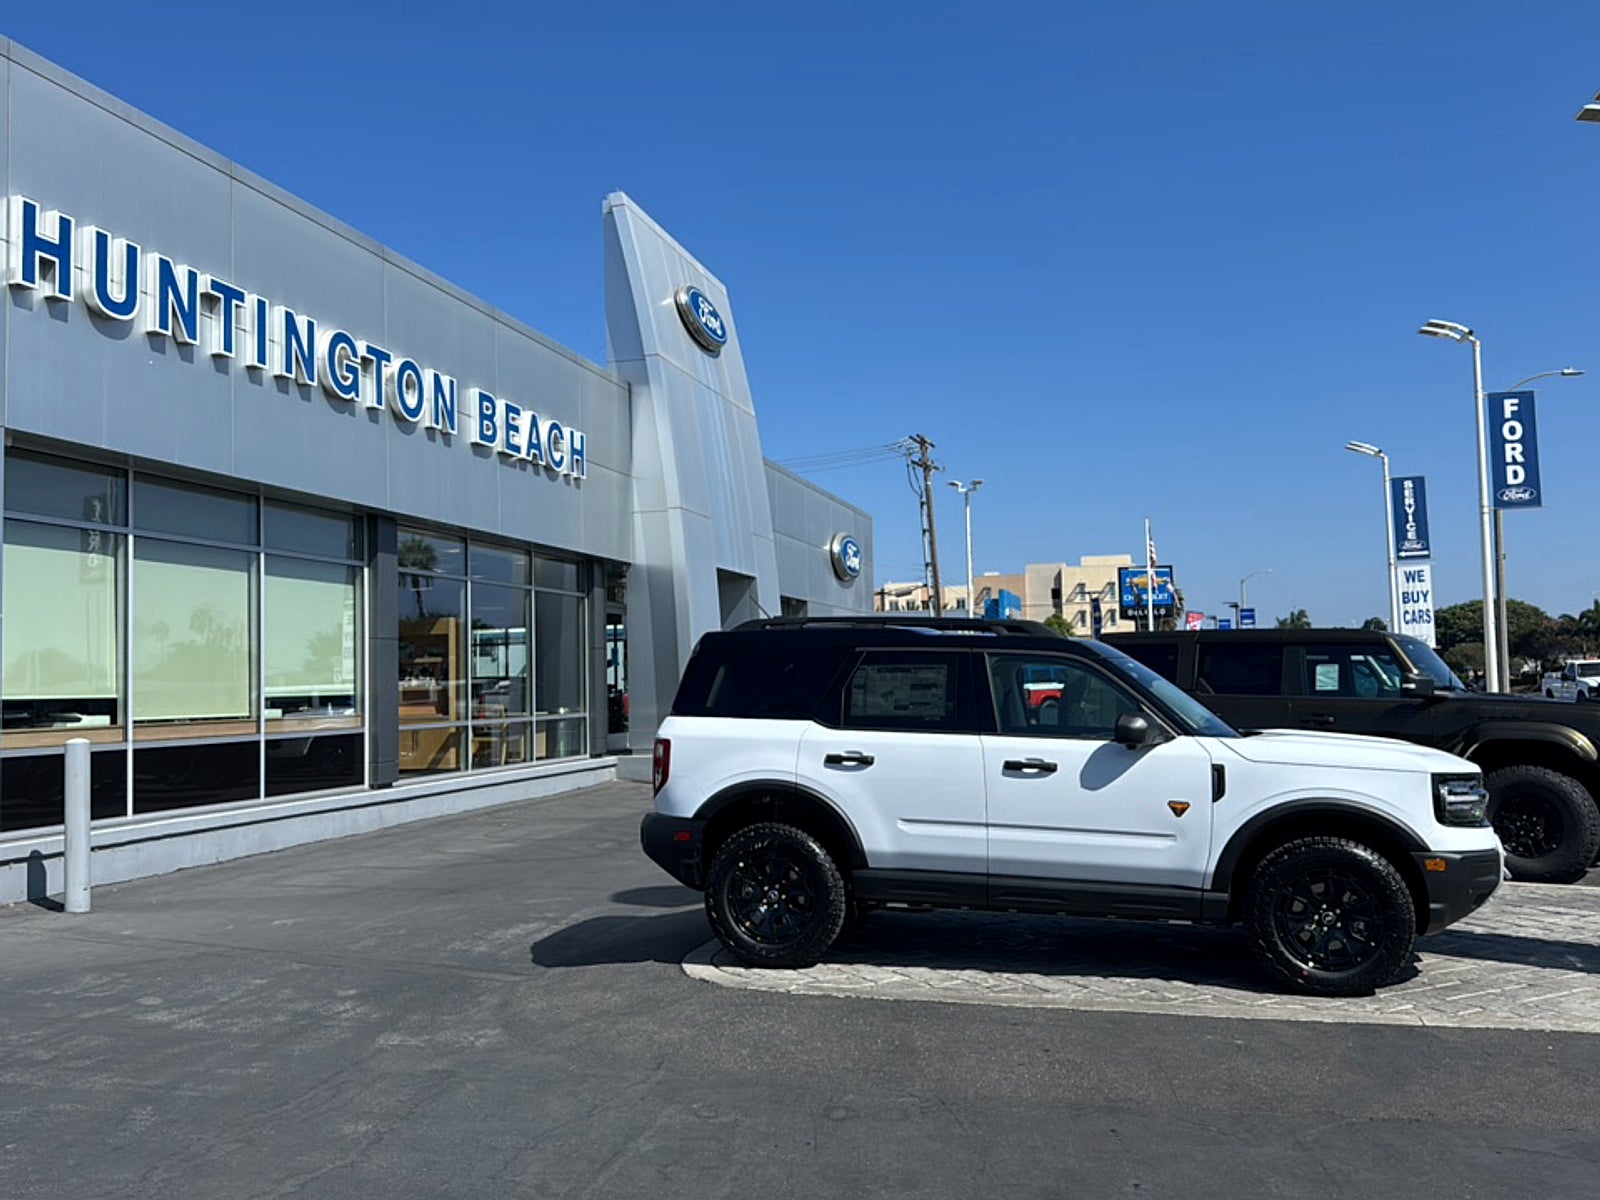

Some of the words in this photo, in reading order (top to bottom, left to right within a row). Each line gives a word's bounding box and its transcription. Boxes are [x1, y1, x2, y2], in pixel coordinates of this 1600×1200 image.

[698, 296, 723, 336] Ford
[8, 194, 458, 436] HUNTINGTON
[470, 387, 587, 480] BEACH
[1502, 398, 1526, 485] FORD
[1502, 488, 1531, 501] Ford
[1403, 480, 1417, 539] SERVICE
[846, 543, 860, 570] Ford
[1403, 569, 1425, 583] WE
[1402, 590, 1429, 605] BUY
[1403, 609, 1431, 625] CARS
